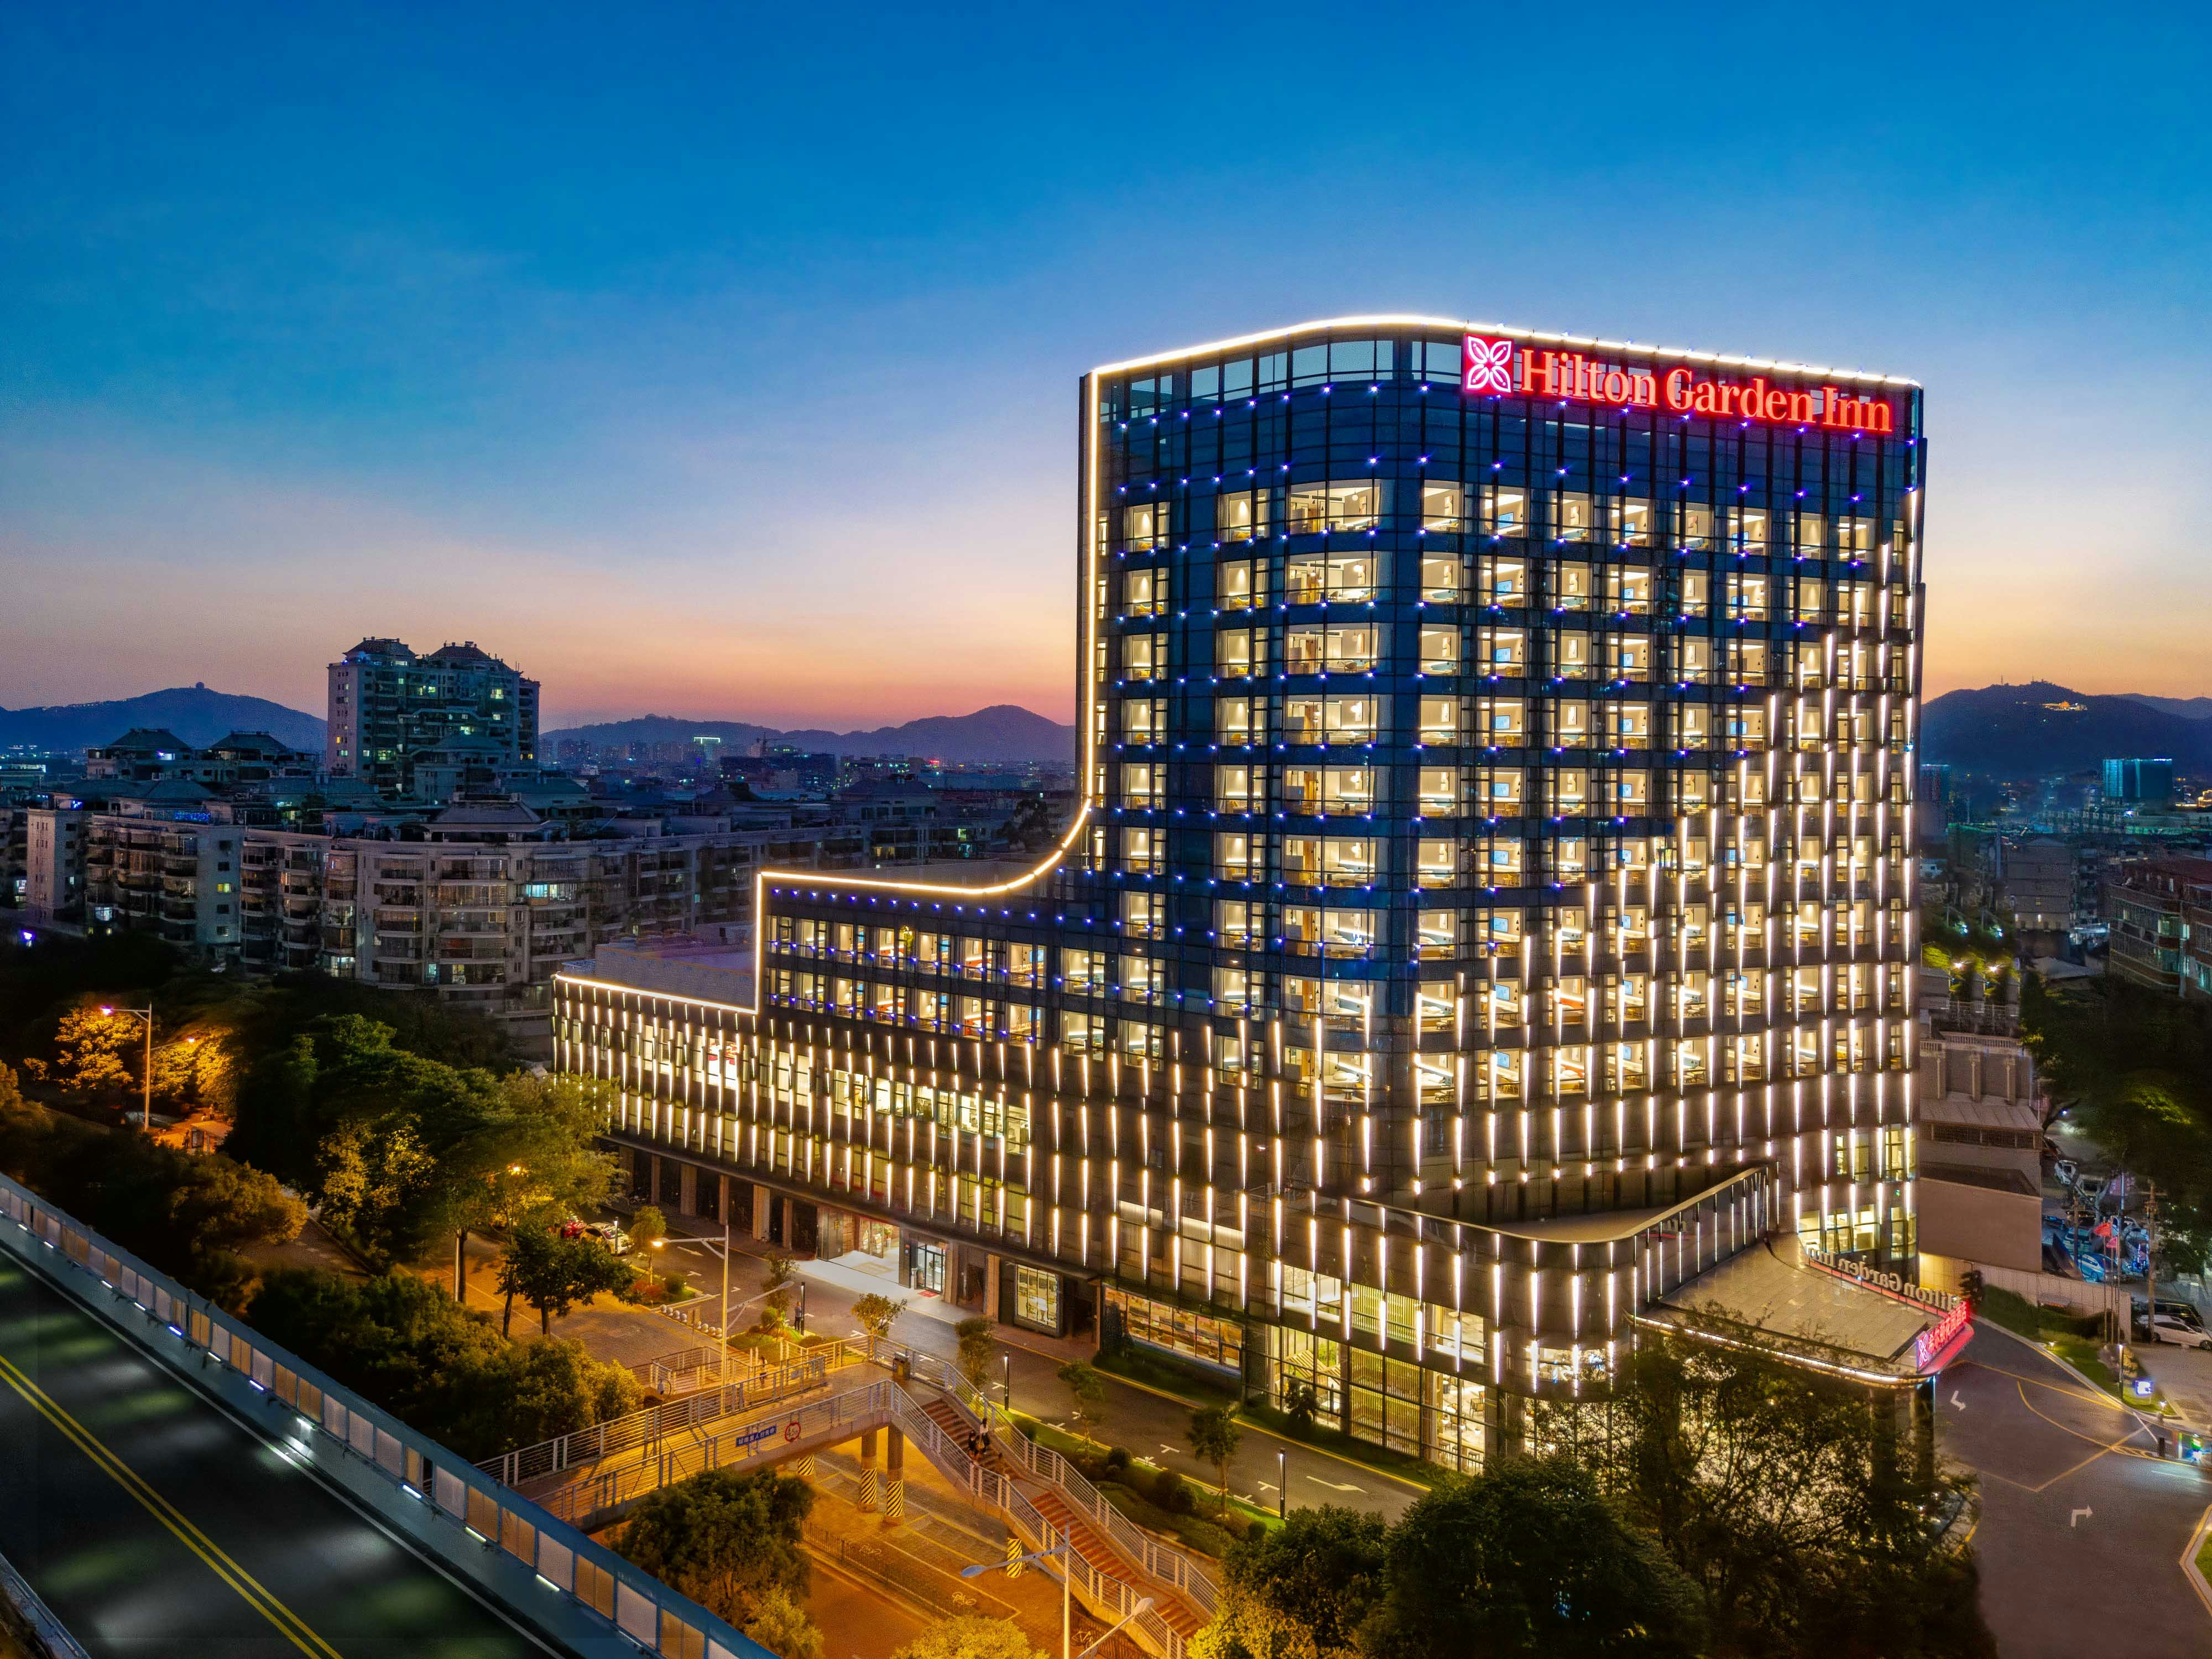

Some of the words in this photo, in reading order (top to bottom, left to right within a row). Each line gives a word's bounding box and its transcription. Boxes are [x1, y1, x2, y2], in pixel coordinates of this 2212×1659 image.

[1521, 348, 1658, 406] Hilton
[1666, 368, 1814, 424] Garden
[1822, 386, 1892, 432] Inn
